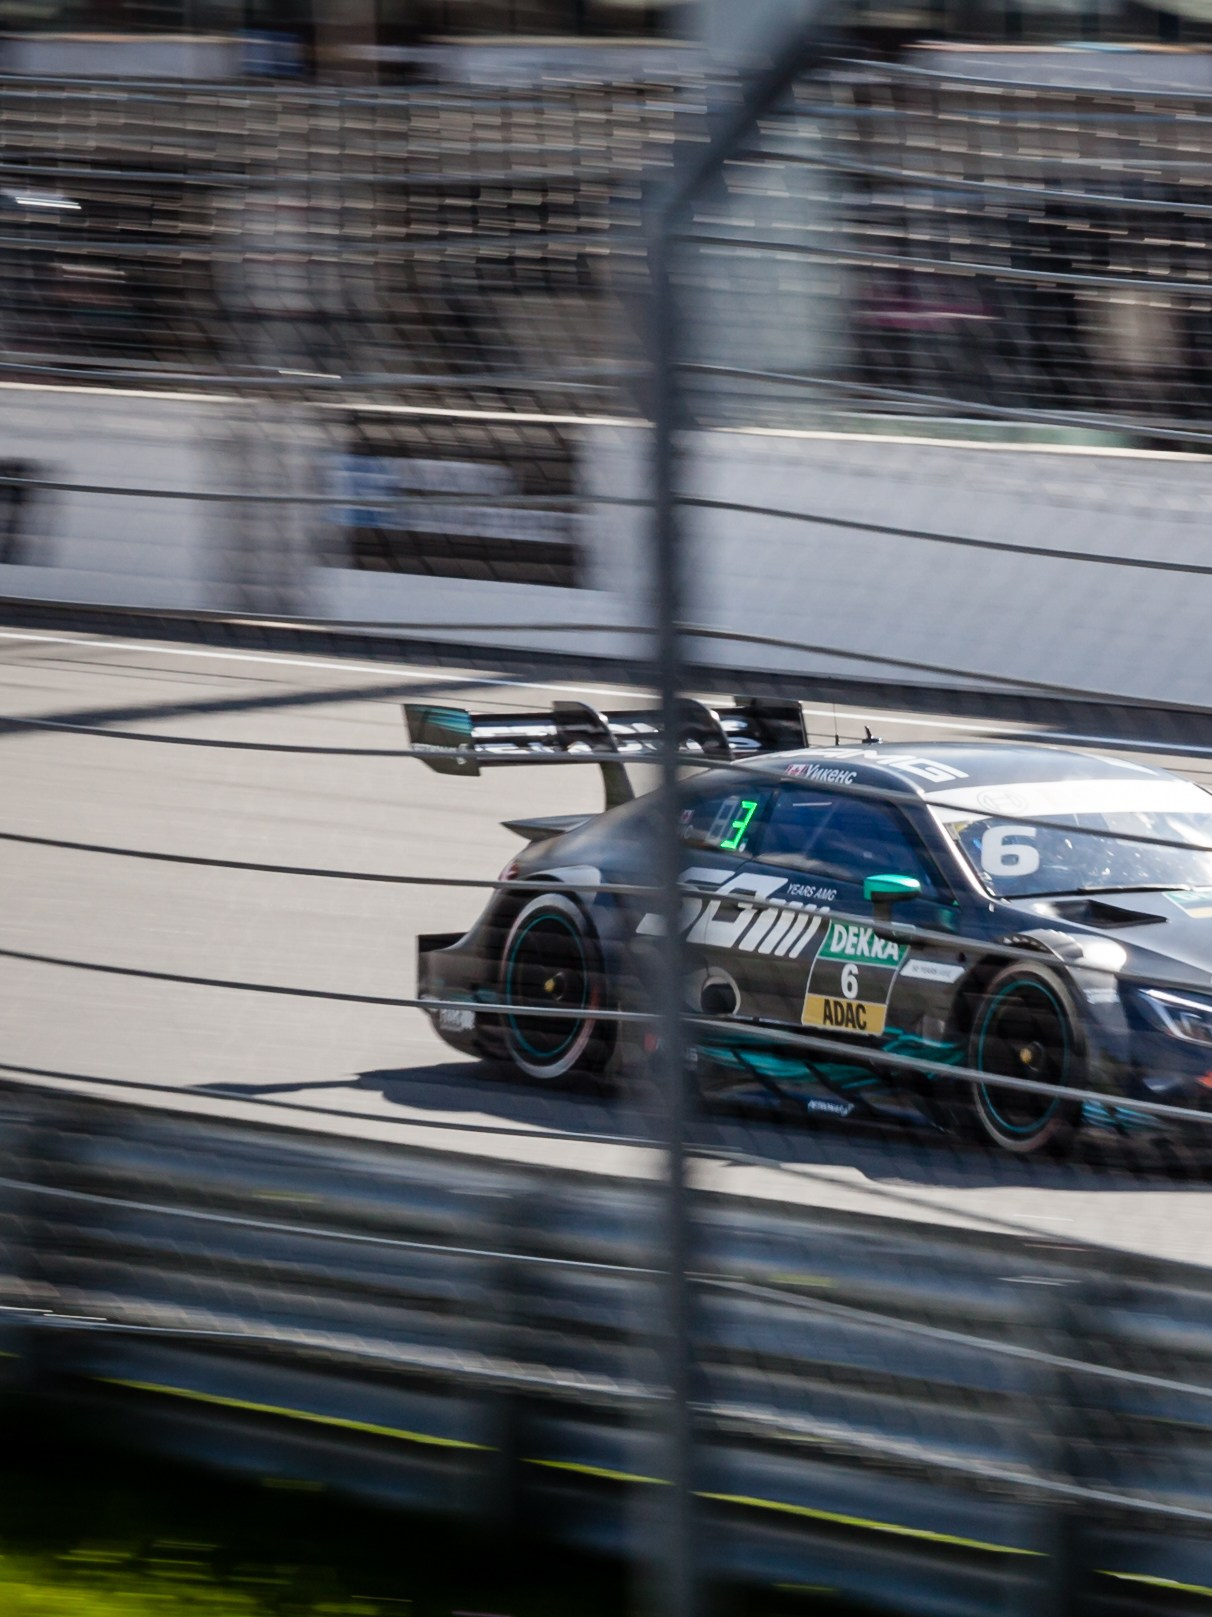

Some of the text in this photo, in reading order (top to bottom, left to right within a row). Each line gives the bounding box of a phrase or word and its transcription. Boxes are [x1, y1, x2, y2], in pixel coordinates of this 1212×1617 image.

[981, 825, 1040, 876] 6
[786, 883, 837, 901] YEARS AMG
[829, 923, 899, 961] DEKRA
[840, 963, 859, 999] 6
[822, 998, 867, 1030] ADAC
